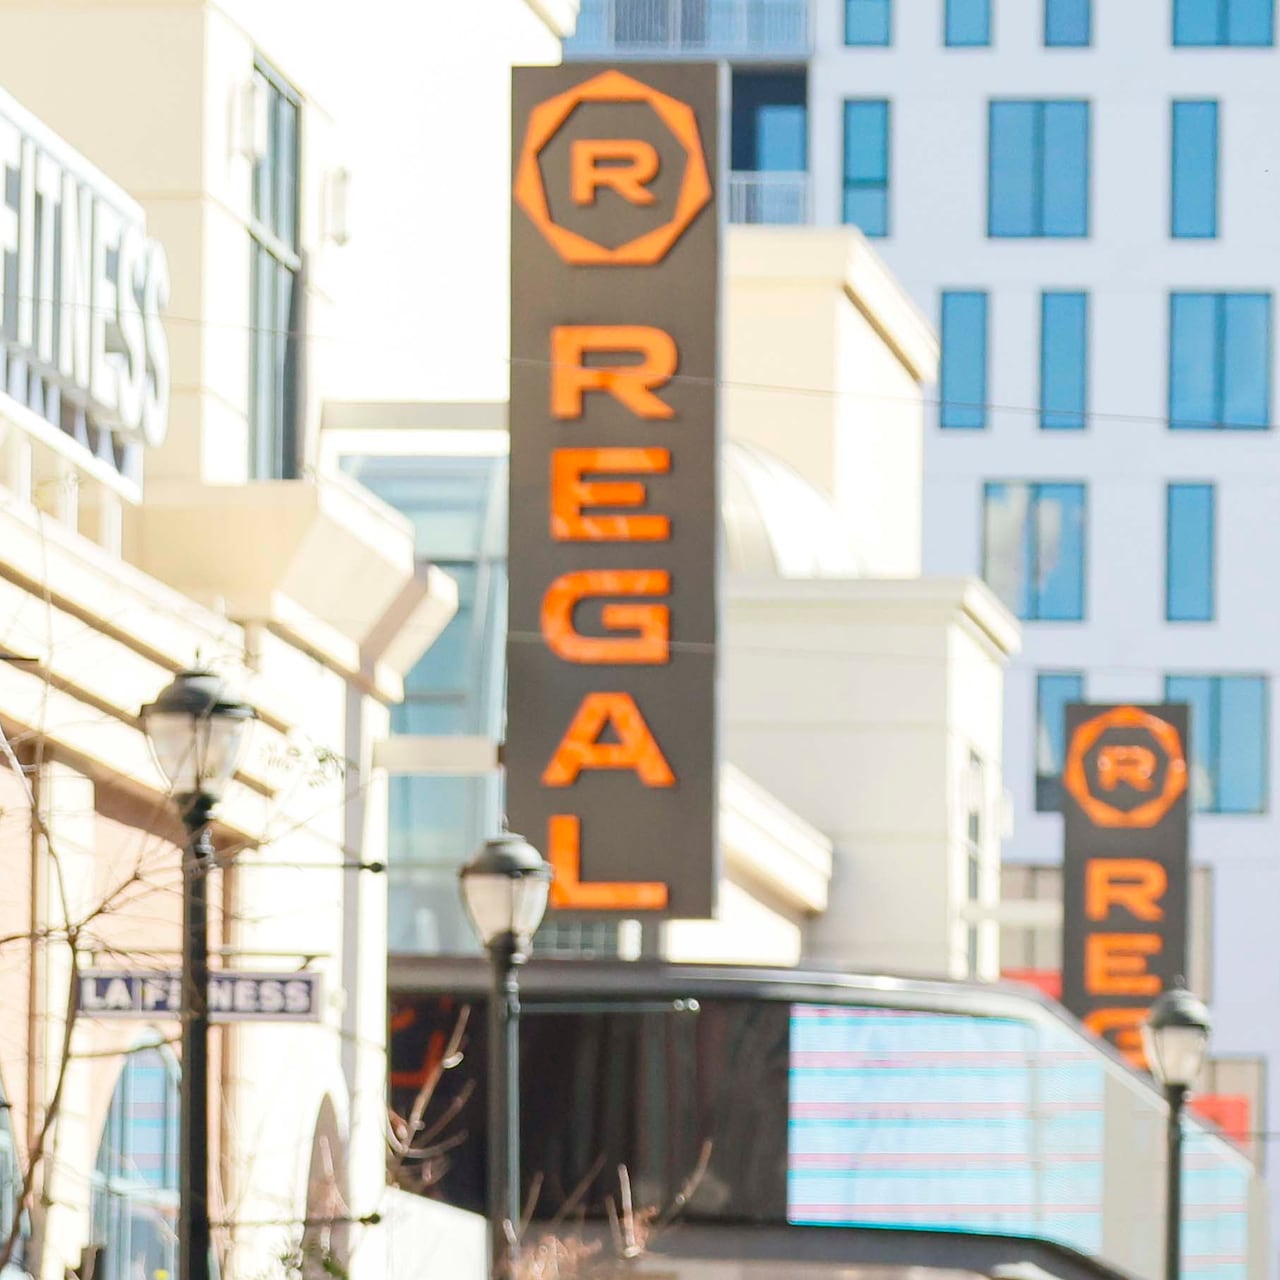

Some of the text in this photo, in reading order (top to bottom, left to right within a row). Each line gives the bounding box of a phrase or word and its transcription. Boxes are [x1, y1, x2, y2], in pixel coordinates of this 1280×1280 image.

[569, 138, 661, 206] R
[540, 324, 680, 911] REGAL
[81, 977, 133, 1010] LA
